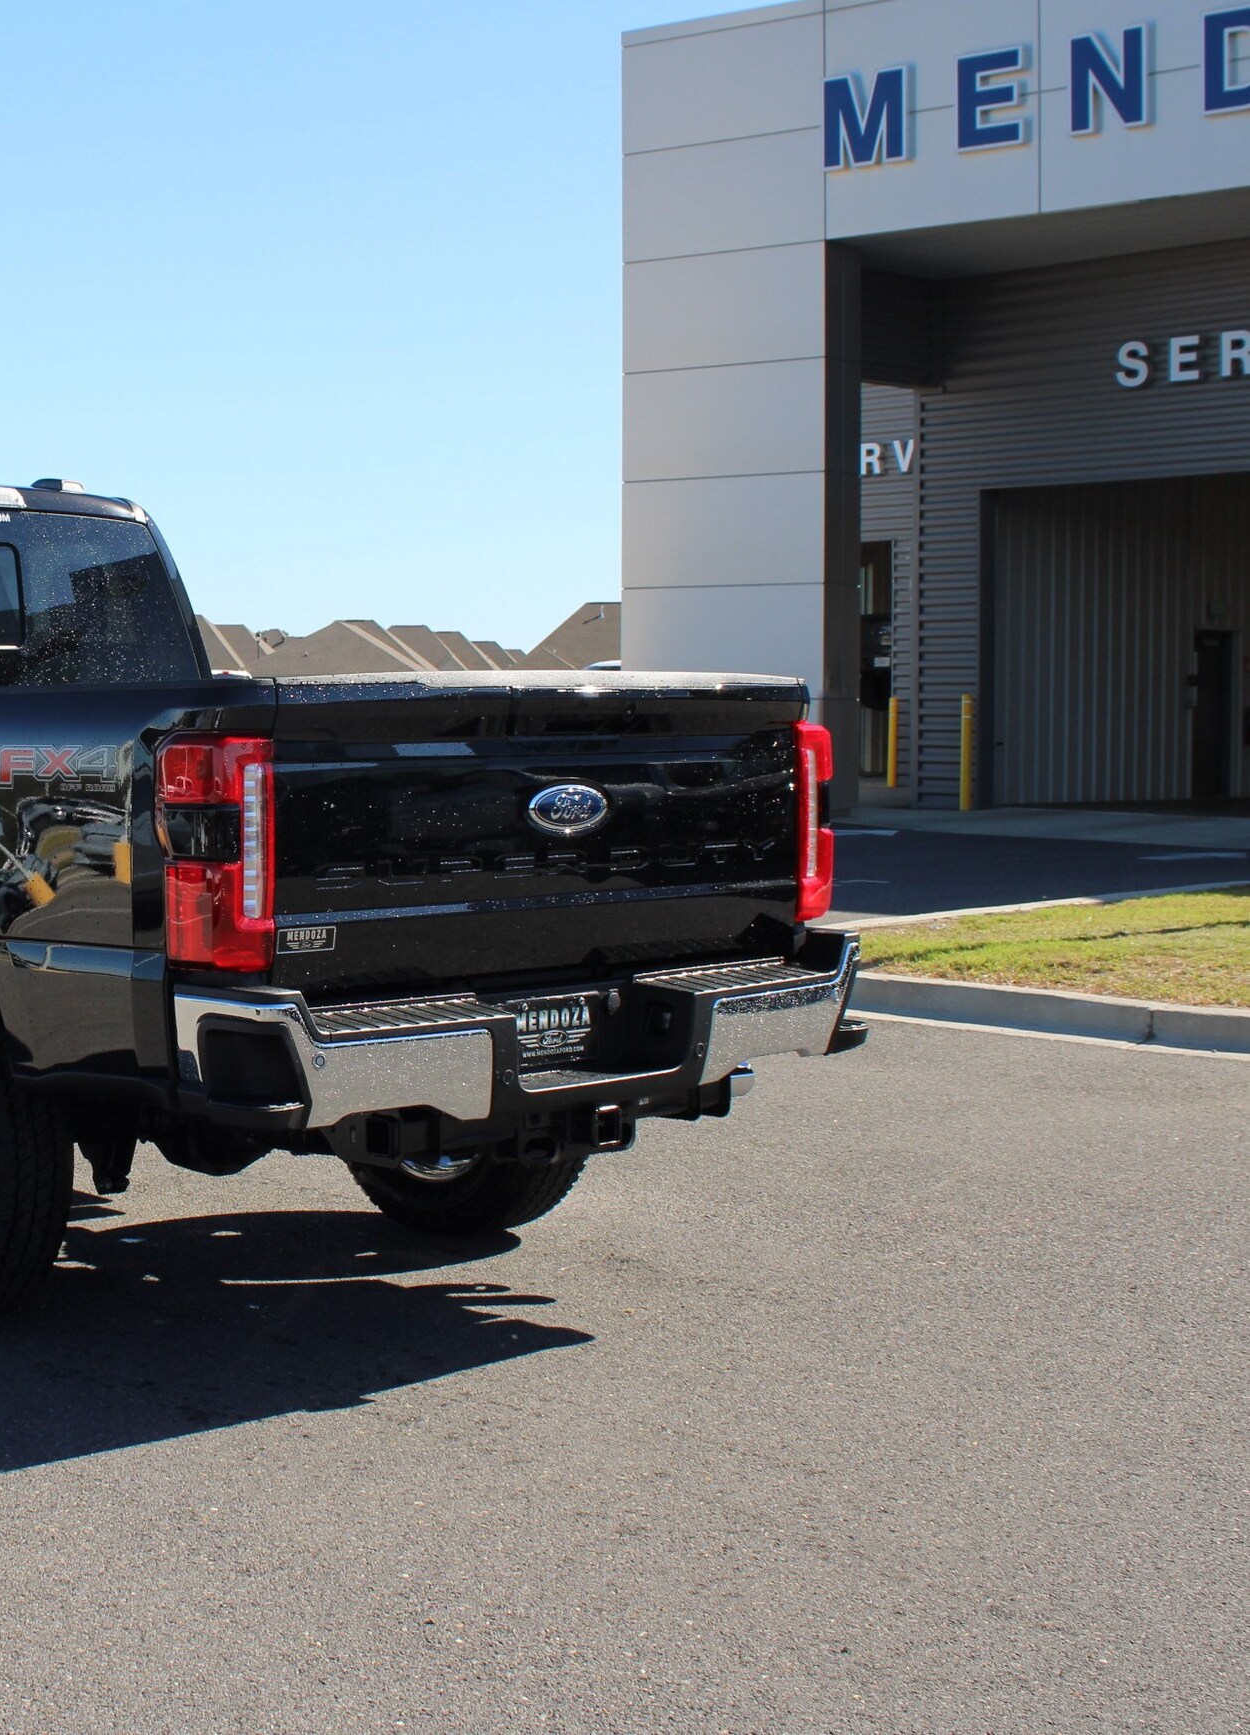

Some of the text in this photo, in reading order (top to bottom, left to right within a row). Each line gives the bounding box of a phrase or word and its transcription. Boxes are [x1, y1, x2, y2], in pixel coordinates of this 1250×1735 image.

[1116, 330, 1250, 388] SER
[314, 837, 776, 891] SUPER DUTY
[286, 929, 327, 942] MENDOZA
[516, 1005, 592, 1033] MENDOZA
